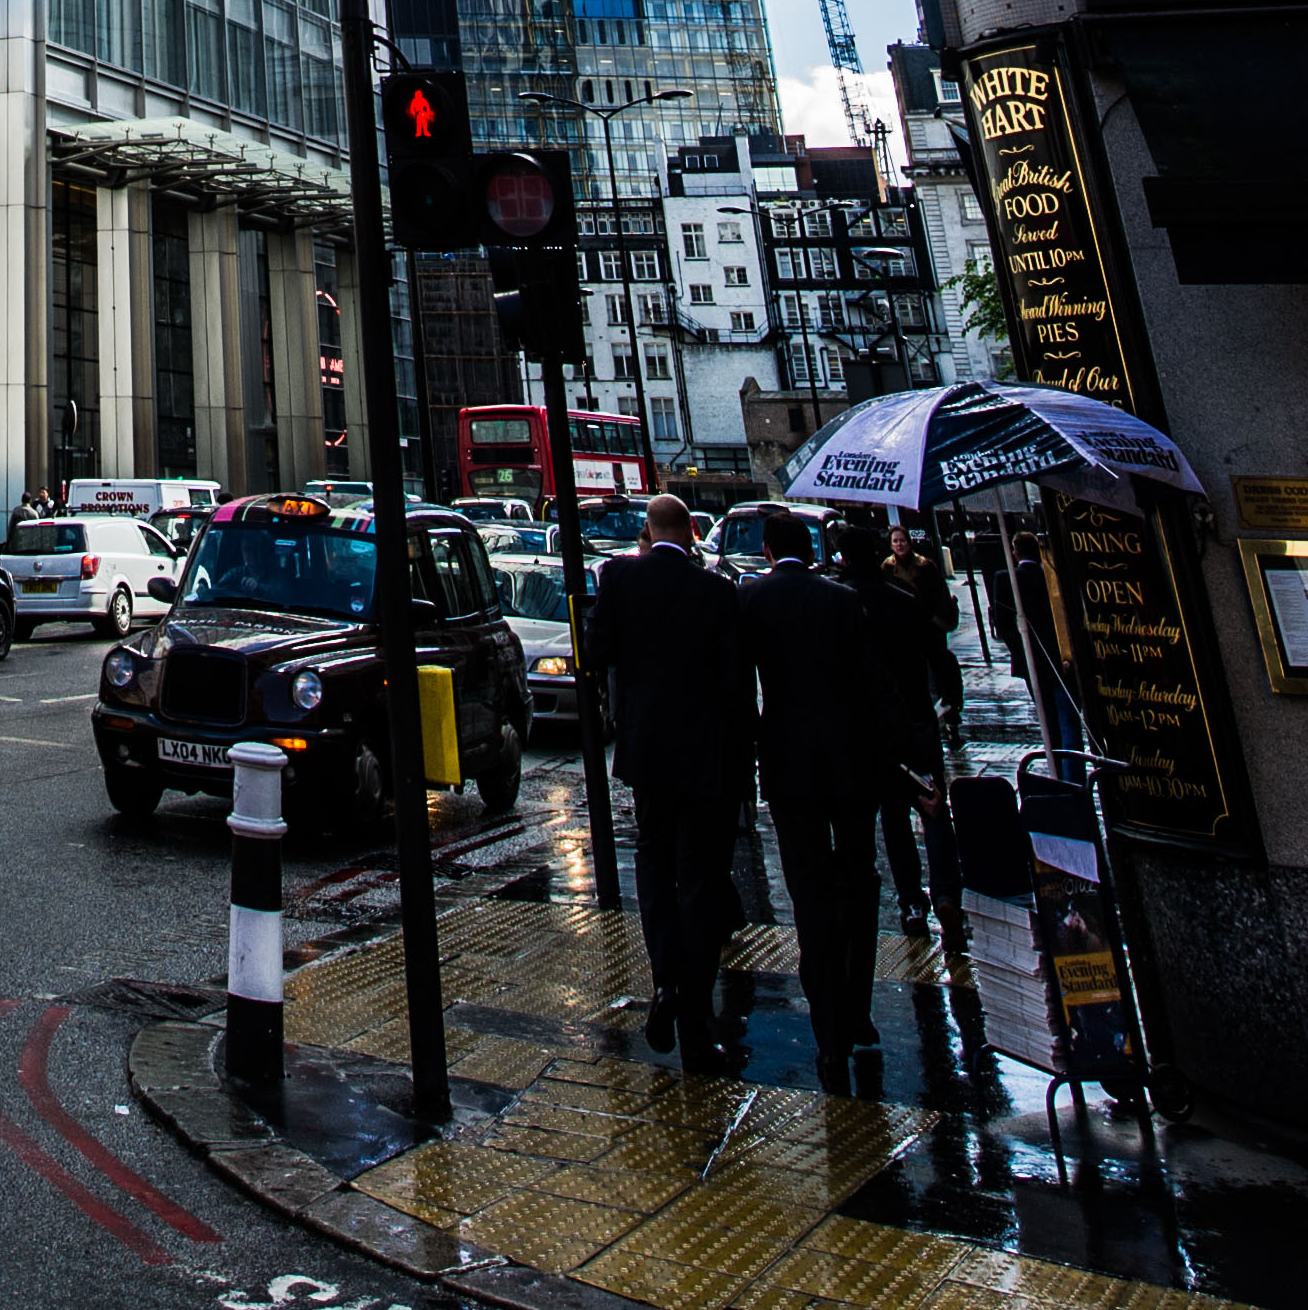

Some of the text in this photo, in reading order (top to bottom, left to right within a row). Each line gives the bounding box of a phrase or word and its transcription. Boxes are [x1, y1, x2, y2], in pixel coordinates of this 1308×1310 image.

[970, 67, 1050, 112] WHITE
[981, 101, 1046, 140] HART
[1012, 160, 1075, 194] British
[1004, 192, 1060, 220] FOOD
[1012, 220, 1059, 245] Served
[1008, 248, 1085, 275] UNTIL 10PM
[1048, 291, 1107, 322] Winning
[1037, 321, 1079, 344] PIES
[1086, 366, 1120, 392] Our
[820, 454, 900, 477] Evening
[813, 470, 904, 492] Standard
[81, 503, 150, 514] PROMOTIONS
[95, 491, 134, 502] CROWN
[1071, 531, 1143, 554] DINING
[1086, 579, 1145, 605] OPEN
[162, 739, 198, 761] LX04
[1058, 963, 1109, 979] Evening
